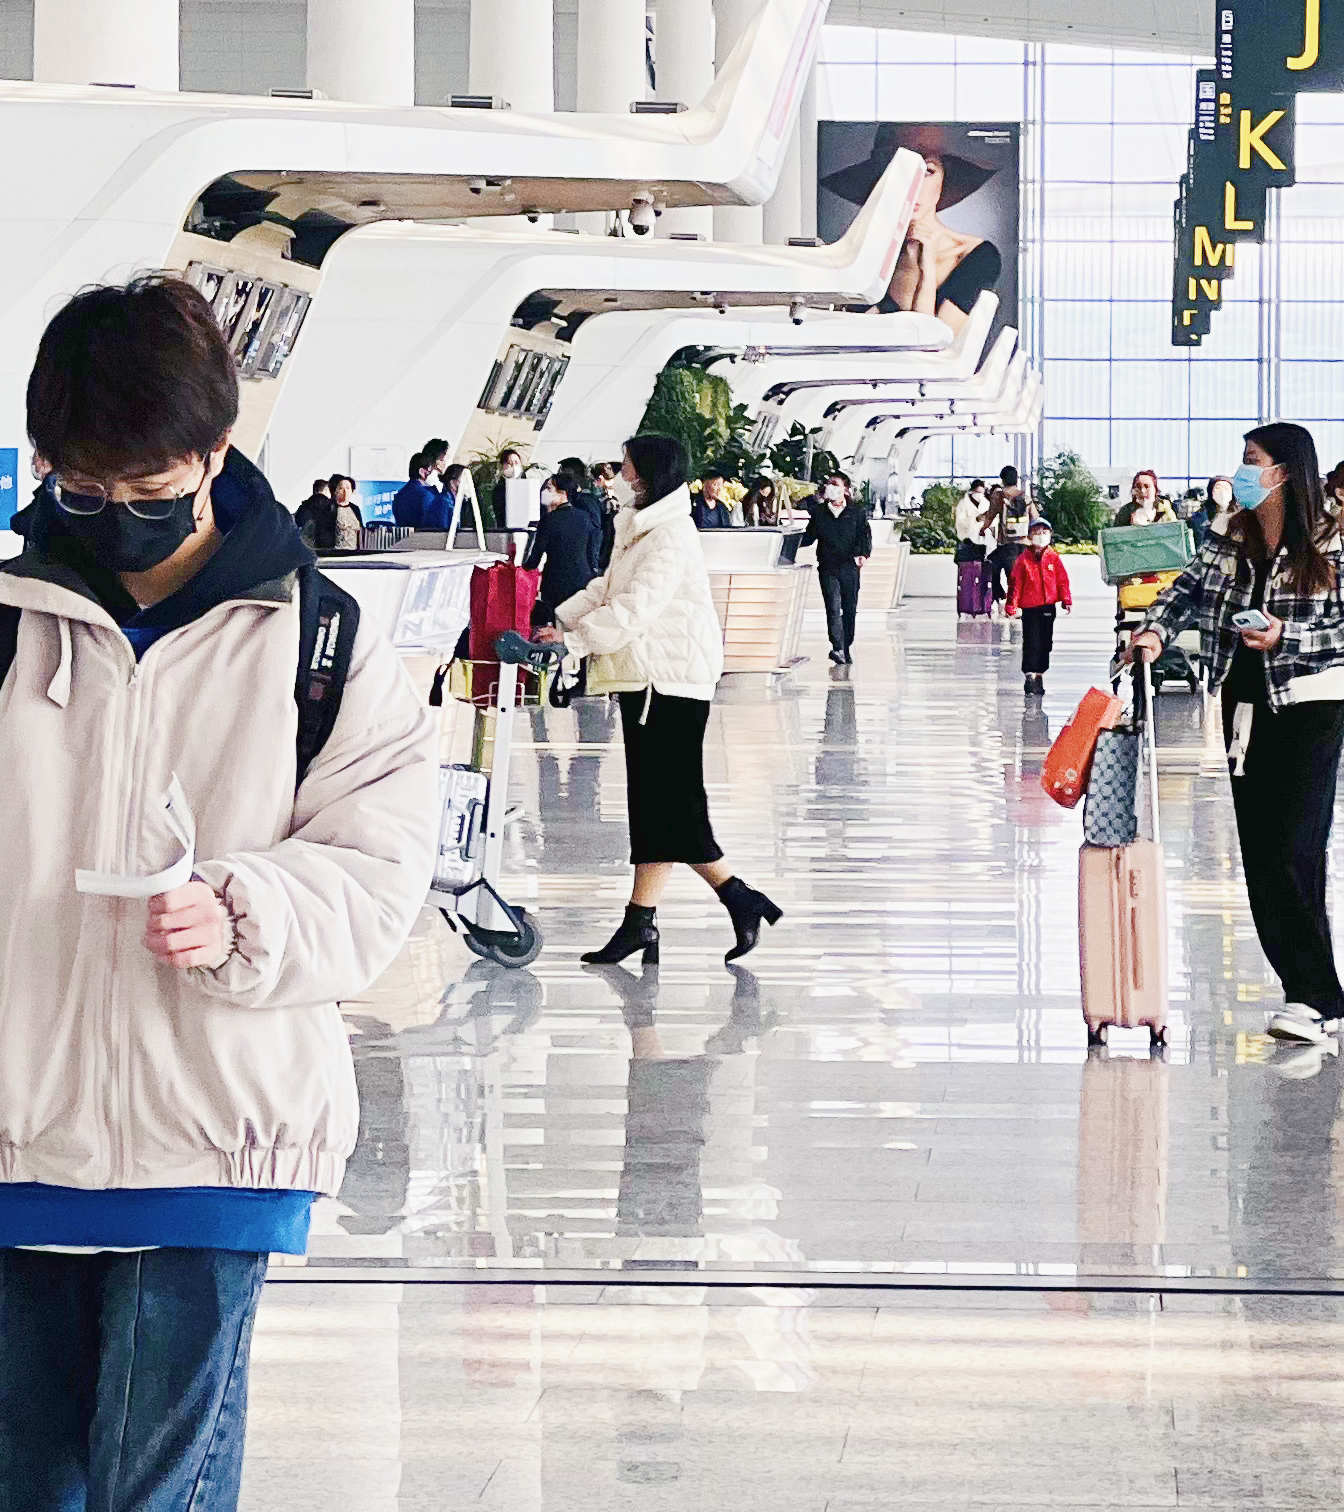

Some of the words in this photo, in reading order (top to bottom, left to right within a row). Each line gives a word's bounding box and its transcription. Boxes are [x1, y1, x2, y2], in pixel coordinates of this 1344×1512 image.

[1238, 109, 1288, 170] K
[1224, 181, 1255, 230] L
[1193, 225, 1235, 267] M
